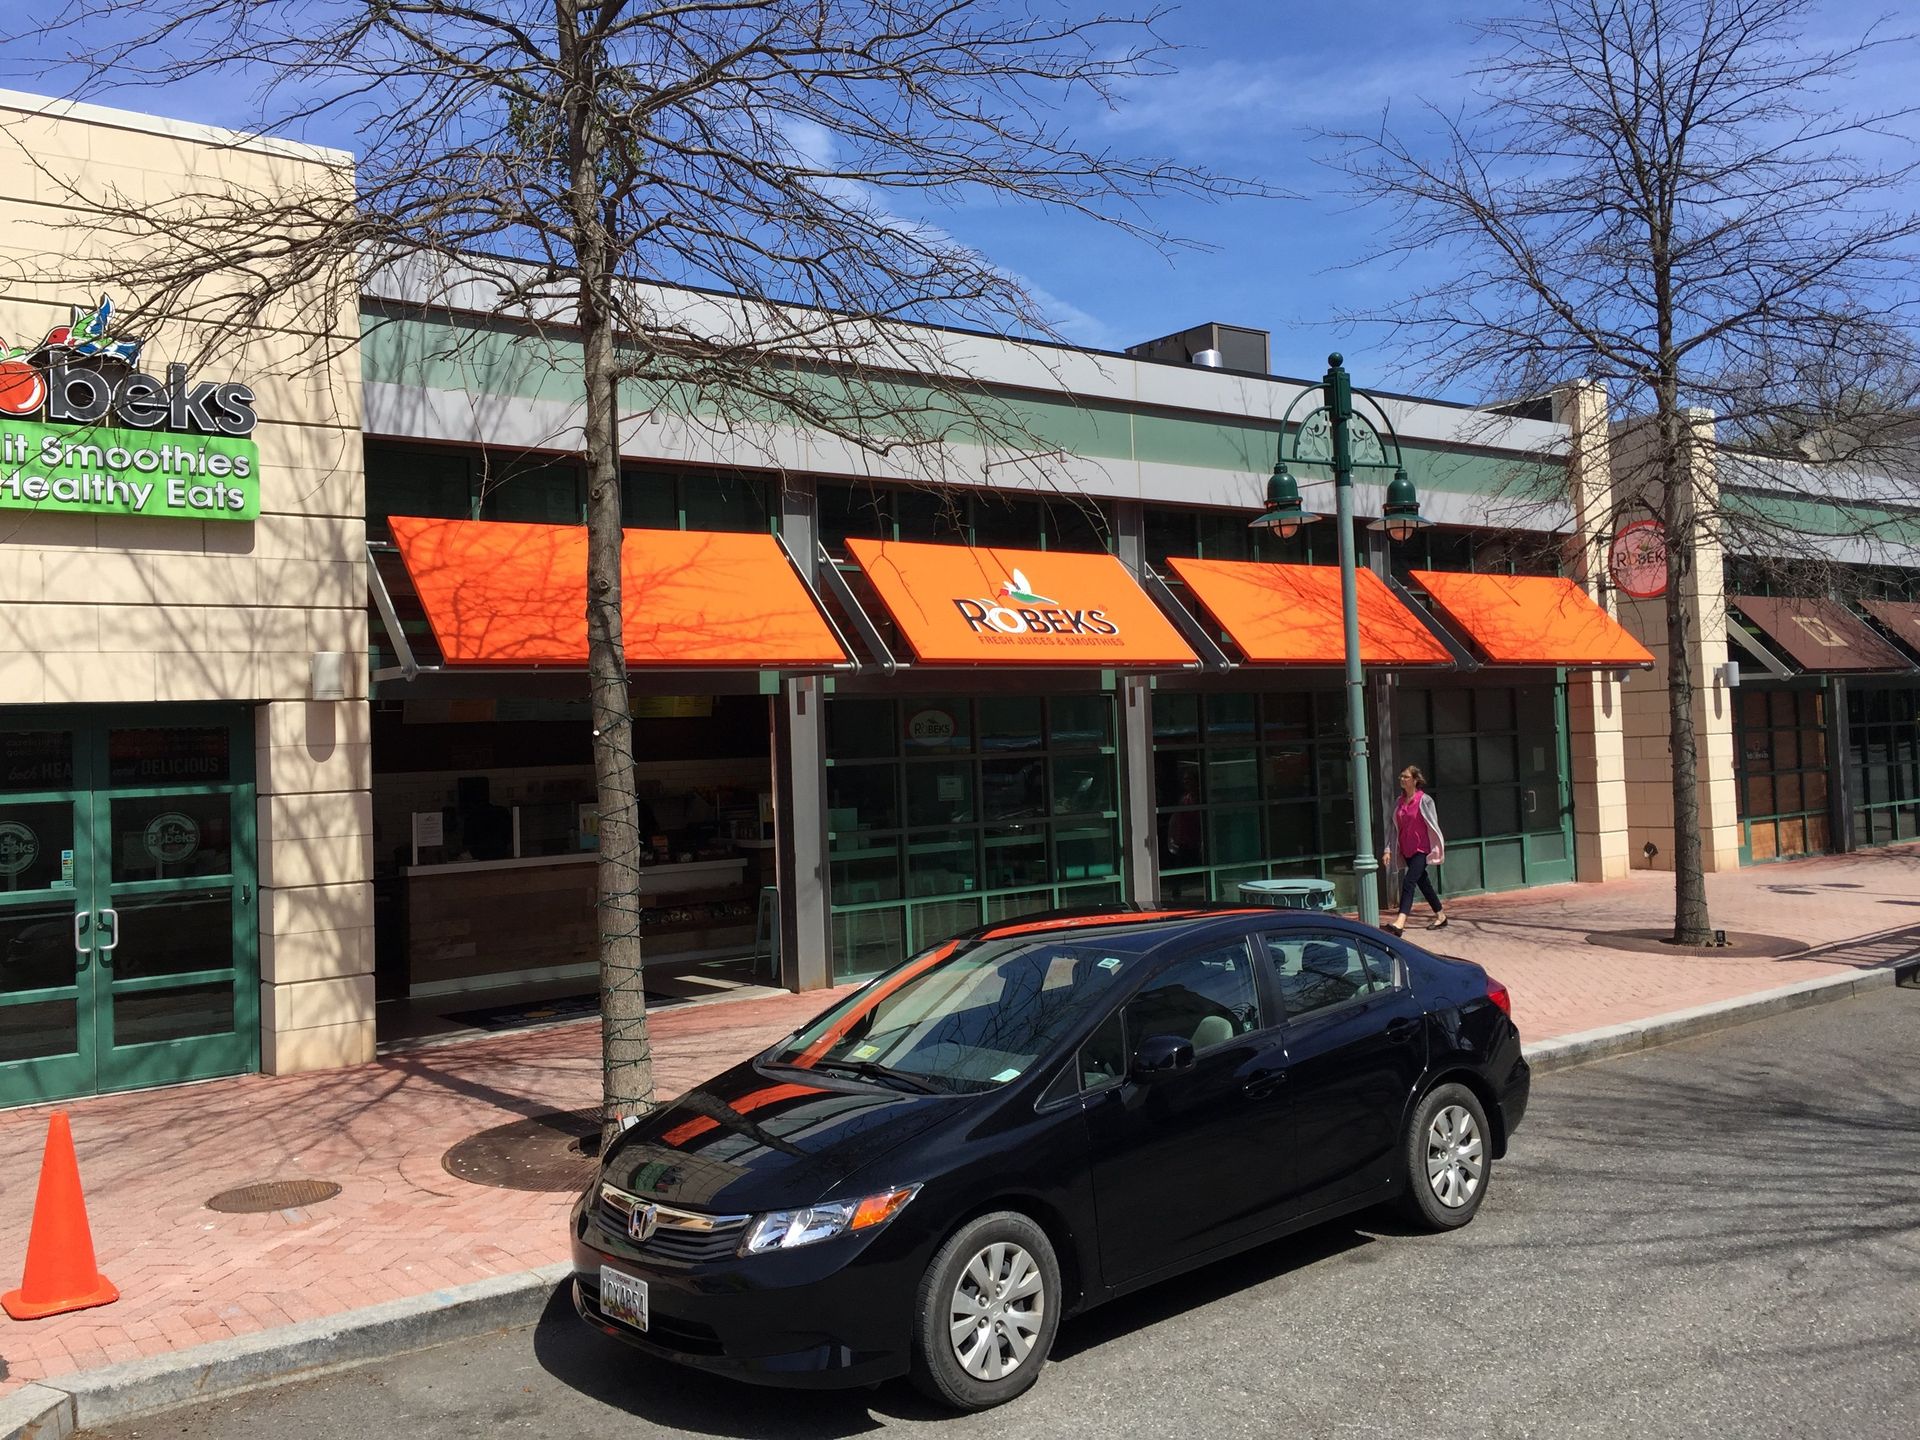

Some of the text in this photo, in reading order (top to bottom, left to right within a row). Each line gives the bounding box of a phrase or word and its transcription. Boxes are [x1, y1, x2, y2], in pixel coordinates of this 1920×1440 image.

[40, 435, 251, 479] Smoothies
[0, 469, 245, 512] Healthy Eats
[952, 598, 1119, 635] ROBEKS
[978, 636, 1126, 647] FRESH JUICES & SMOOTHIES
[141, 755, 219, 776] DELICIOUS
